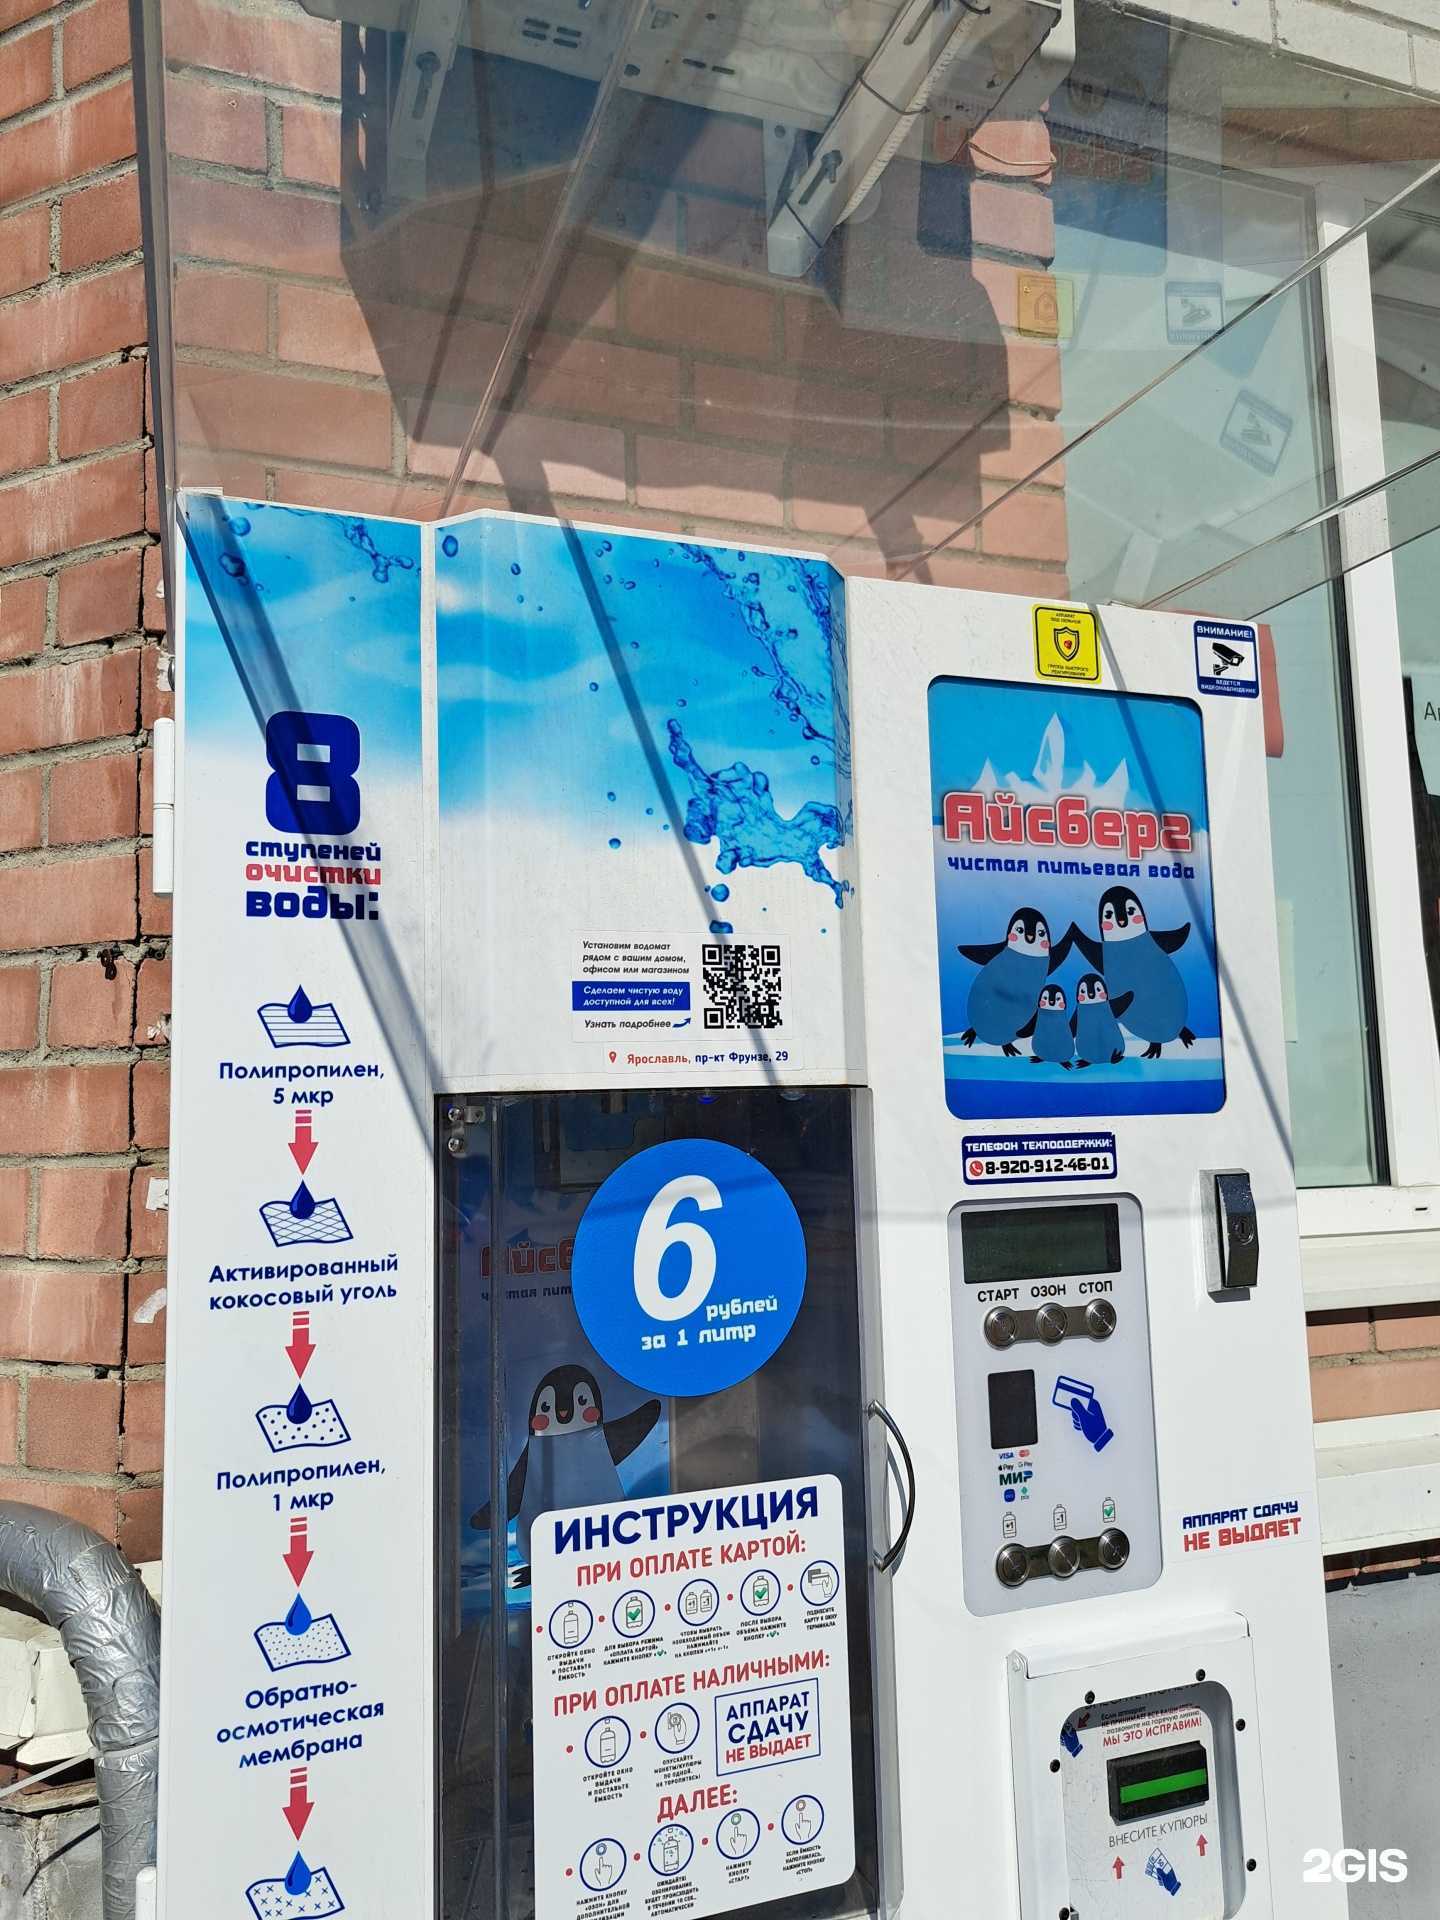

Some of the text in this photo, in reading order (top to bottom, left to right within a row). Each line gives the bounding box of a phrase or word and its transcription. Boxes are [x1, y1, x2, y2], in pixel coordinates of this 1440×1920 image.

[1197, 626, 1252, 638] ВНИМАНИЕ!
[265, 711, 361, 835] 8
[943, 792, 1192, 861] Айсберг
[246, 841, 381, 862] ступеней
[246, 864, 381, 885] очистки
[947, 856, 1195, 880] чистая питьевая вода
[246, 886, 379, 920] воды:
[582, 941, 671, 950] Установим водомат
[582, 954, 610, 963] рядом
[583, 966, 621, 975] офисом
[584, 986, 683, 996] Сделаем чистую воду
[583, 997, 631, 1007] доступной
[652, 998, 676, 1006] всех!
[584, 1020, 671, 1030] Узнать подробнее
[627, 1051, 788, 1065] Ярославль, пр-кт Фрунзе, 29
[219, 1062, 384, 1082] Полипропилен,
[272, 1087, 334, 1107] 5 мкр
[966, 1138, 1113, 1152] ТЕЛЕФОН ТЕХПОДДЕРЖКИ:
[986, 1157, 1110, 1175] 8-920-912-46-01
[634, 1174, 723, 1321] 6
[208, 1254, 398, 1283] Активированный
[1030, 1284, 1066, 1298] ОЗОН
[1079, 1280, 1112, 1294] СТОП
[209, 1284, 397, 1310] кокосовый уголь
[978, 1288, 1020, 1302] СТАРТ
[706, 1295, 778, 1322] рублей
[641, 1324, 756, 1350] за 1 литр
[216, 1459, 386, 1490] Полипропилен,
[1000, 1470, 1033, 1486] МИР
[273, 1490, 334, 1511] 1 мкр
[554, 1486, 818, 1554] ИНСТРУКЦИЯ
[1182, 1500, 1298, 1530] АППАРАТ СДАЧУ
[1183, 1517, 1302, 1552] НЕ ВЫДАЕТ
[576, 1529, 806, 1587] ПРИ ОПЛАТЕ КАРТОЙ:
[806, 1607, 834, 1616] ПОДНЕСИТЕ
[760, 1616, 782, 1624] ВЫБОРА
[760, 1622, 786, 1632] НАЖМИТЕ
[804, 1616, 819, 1624] КАРТУ
[806, 1622, 836, 1631] ТЕРМИНАЛА
[699, 1626, 722, 1634] ВЫБРАТЬ
[744, 1633, 764, 1641] КНОПКУ
[604, 1637, 664, 1652] ДЛЯ ВЫБОРА РЕЖИМА
[672, 1633, 712, 1644] НЕОБХОДИМЫЙ
[686, 1640, 718, 1650] НАЖИМАЙТЕ
[548, 1648, 596, 1661] ОТКРОЙТЕ ОКНО
[604, 1652, 652, 1666] НАЖМИТЕ КНОПКУ
[683, 1649, 704, 1657] КНОПКИ
[558, 1663, 592, 1674] ПОСТАВЬТЕ
[560, 1658, 584, 1666] ВЫДАЧИ
[554, 1649, 830, 1716] ПРИ ОПЛАТЕ НАЛИЧНЫМИ:
[245, 1680, 357, 1710] Обратно-
[726, 1691, 810, 1721] АППАРАТ
[216, 1702, 385, 1743] осмотическая
[728, 1710, 809, 1744] СДАЧУ
[1106, 1722, 1140, 1735] позвоните
[1152, 1714, 1178, 1725] горячую
[1103, 1716, 1202, 1747] МЫ ЭТО ИСПРАВИМ!
[239, 1734, 363, 1768] мембрана
[726, 1734, 812, 1763] НЕ ВЫДАЕТ
[654, 1760, 702, 1774] МОНЕТЫ/КУПЮРЫ
[662, 1754, 693, 1765] ОПУСКАЙТЕ
[582, 1766, 634, 1782] ОТКРОЙТЕ ОКНО
[664, 1774, 700, 1786] ТОРОПИТЕСЬ!
[594, 1783, 629, 1795] ПОСТАВЬТЕ
[595, 1777, 622, 1787] ВЫДАЧИ
[657, 1784, 738, 1823] ДАЛЕЕ:
[1109, 1813, 1208, 1848] ВНЕСИТЕ КУПЮРЫ
[726, 1860, 752, 1870] НАЖМИТЕ
[782, 1857, 826, 1871] НАЖМИТЕ КНОПКУ
[728, 1868, 750, 1877] КНОПКУ
[652, 1882, 692, 1896] ОЗОНИРОВАНИЕ
[657, 1876, 687, 1887] ОЖИДАЙТЕ!
[576, 1889, 628, 1906] НАЖМИТЕ КНОПКУ
[644, 1887, 699, 1904] БУДЕТ ПРОИСХОДИТЬ
[576, 1902, 630, 1920] ДОПОЛНИТЕЛЬНОЙ
[650, 1902, 694, 1917] АВТОМАТИЧЕСКИ
